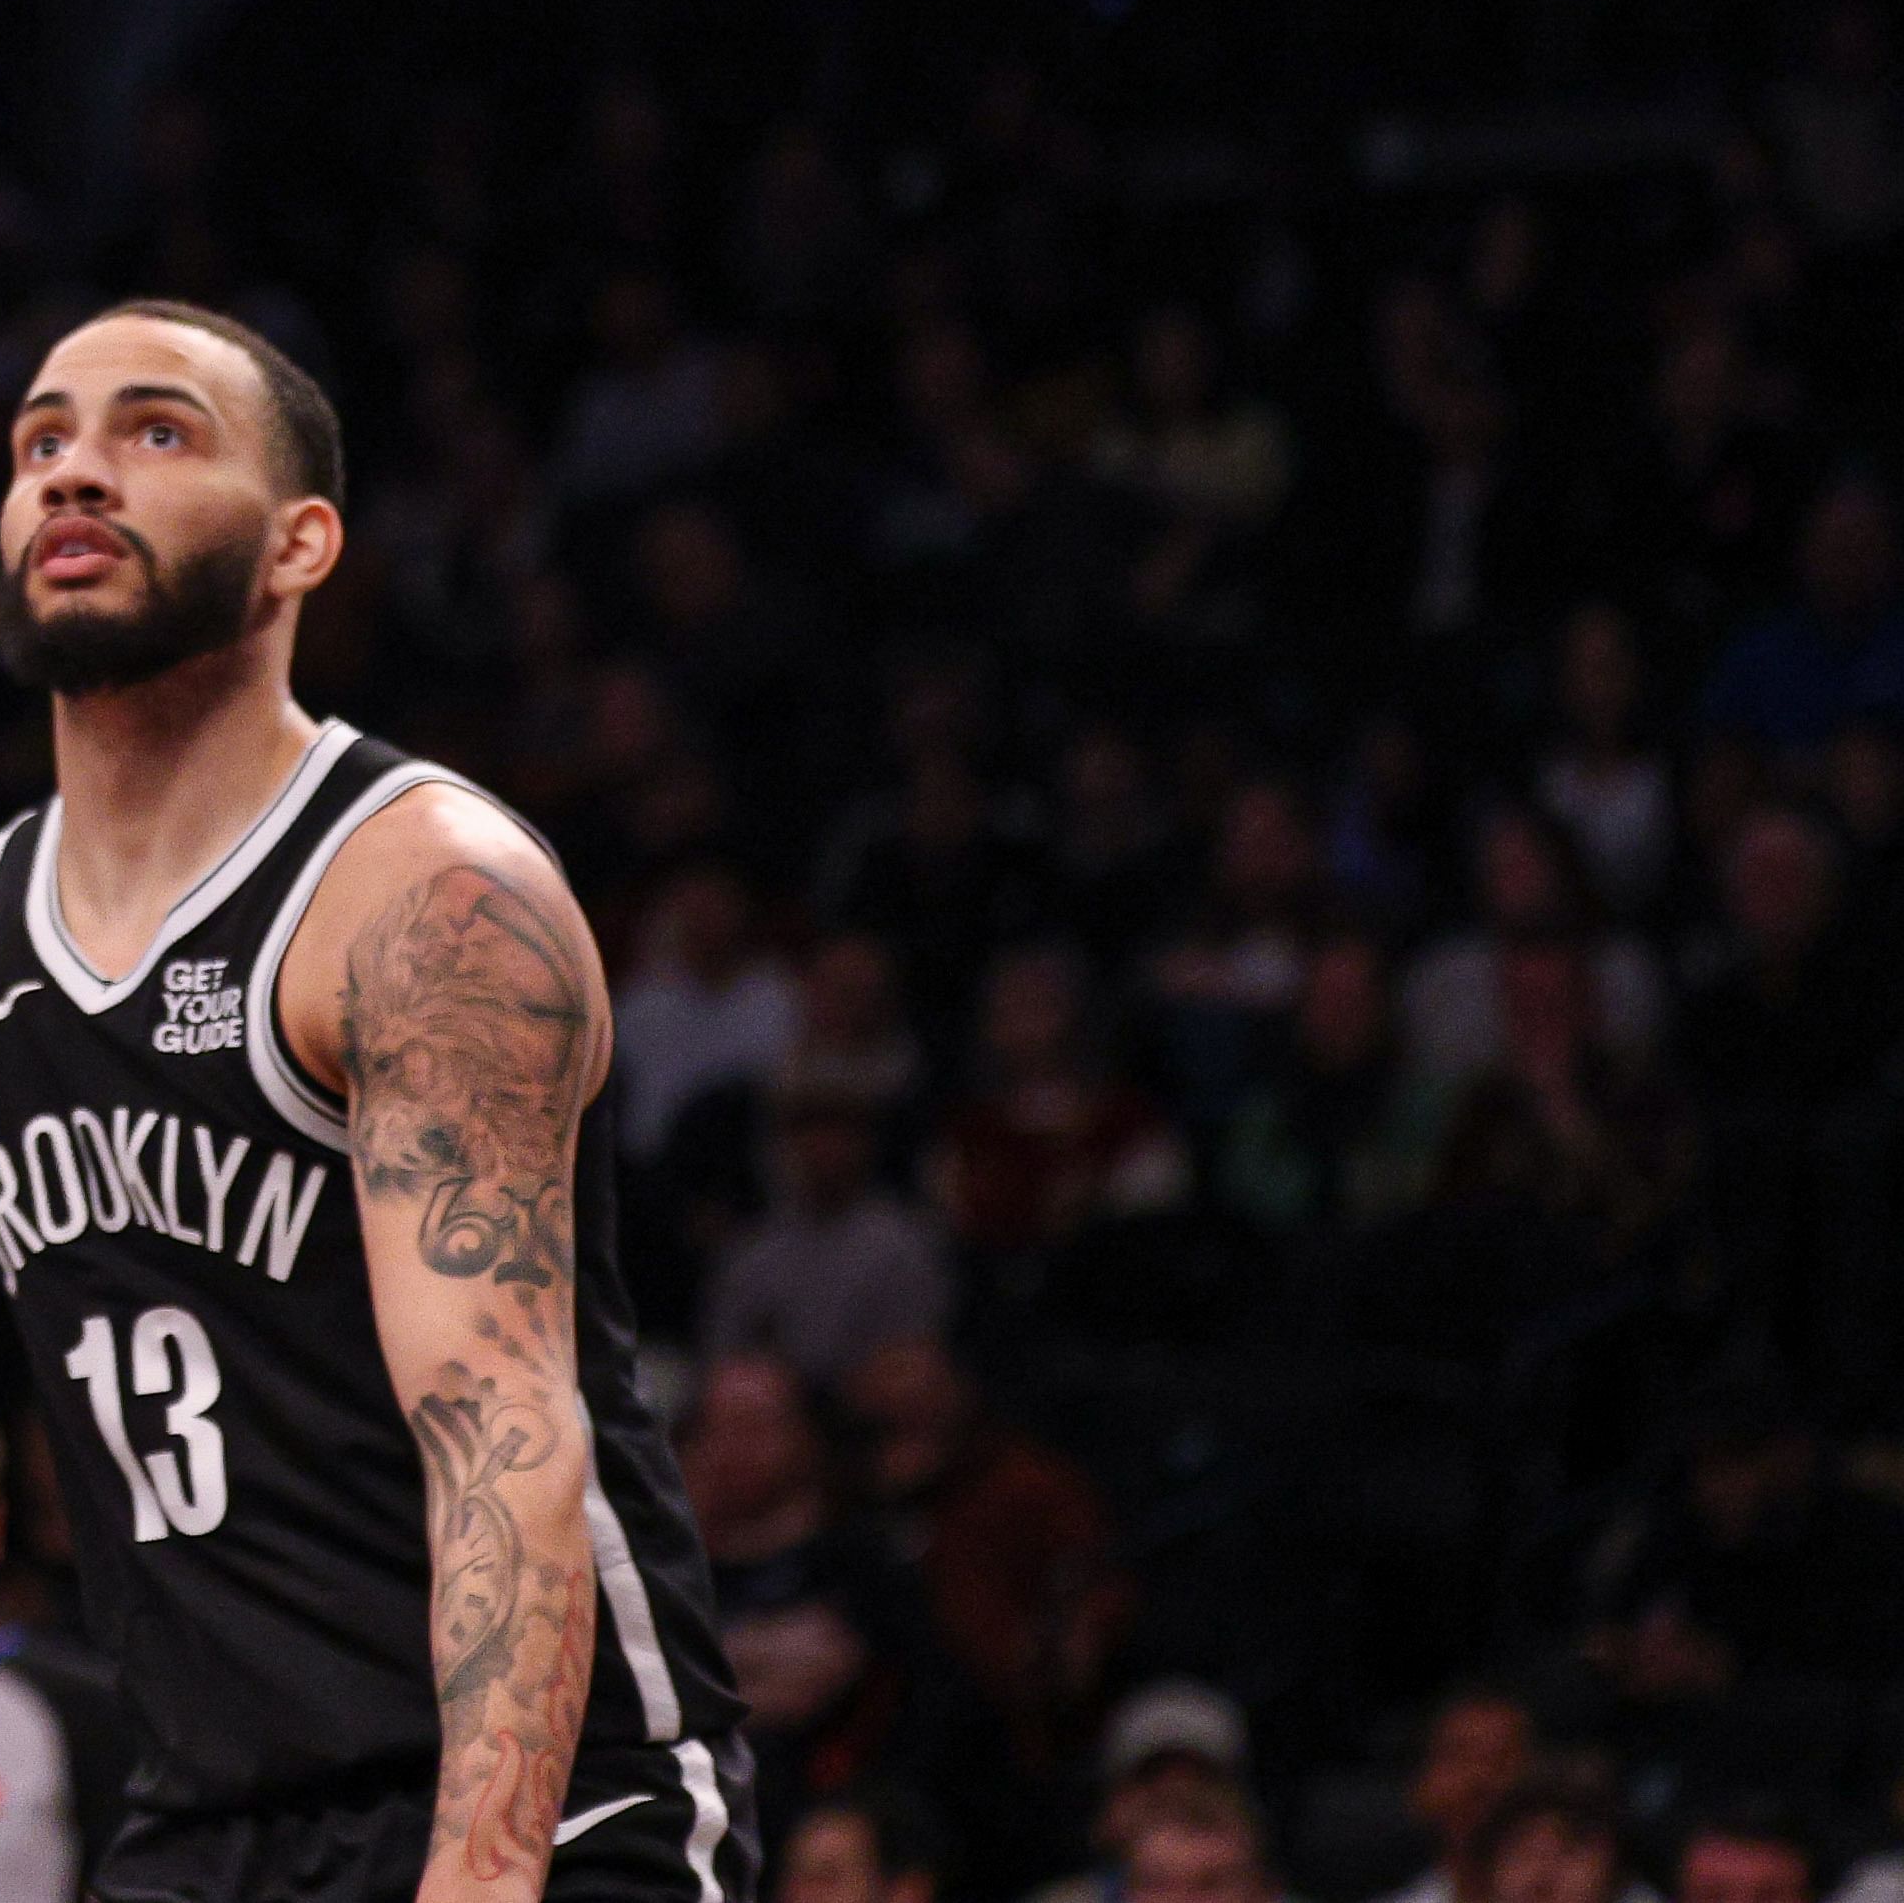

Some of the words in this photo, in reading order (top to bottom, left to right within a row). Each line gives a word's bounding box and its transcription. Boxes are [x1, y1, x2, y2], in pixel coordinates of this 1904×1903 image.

[164, 959, 229, 992] GET
[161, 985, 242, 1024] YOUR
[64, 1306, 228, 1543] 13
